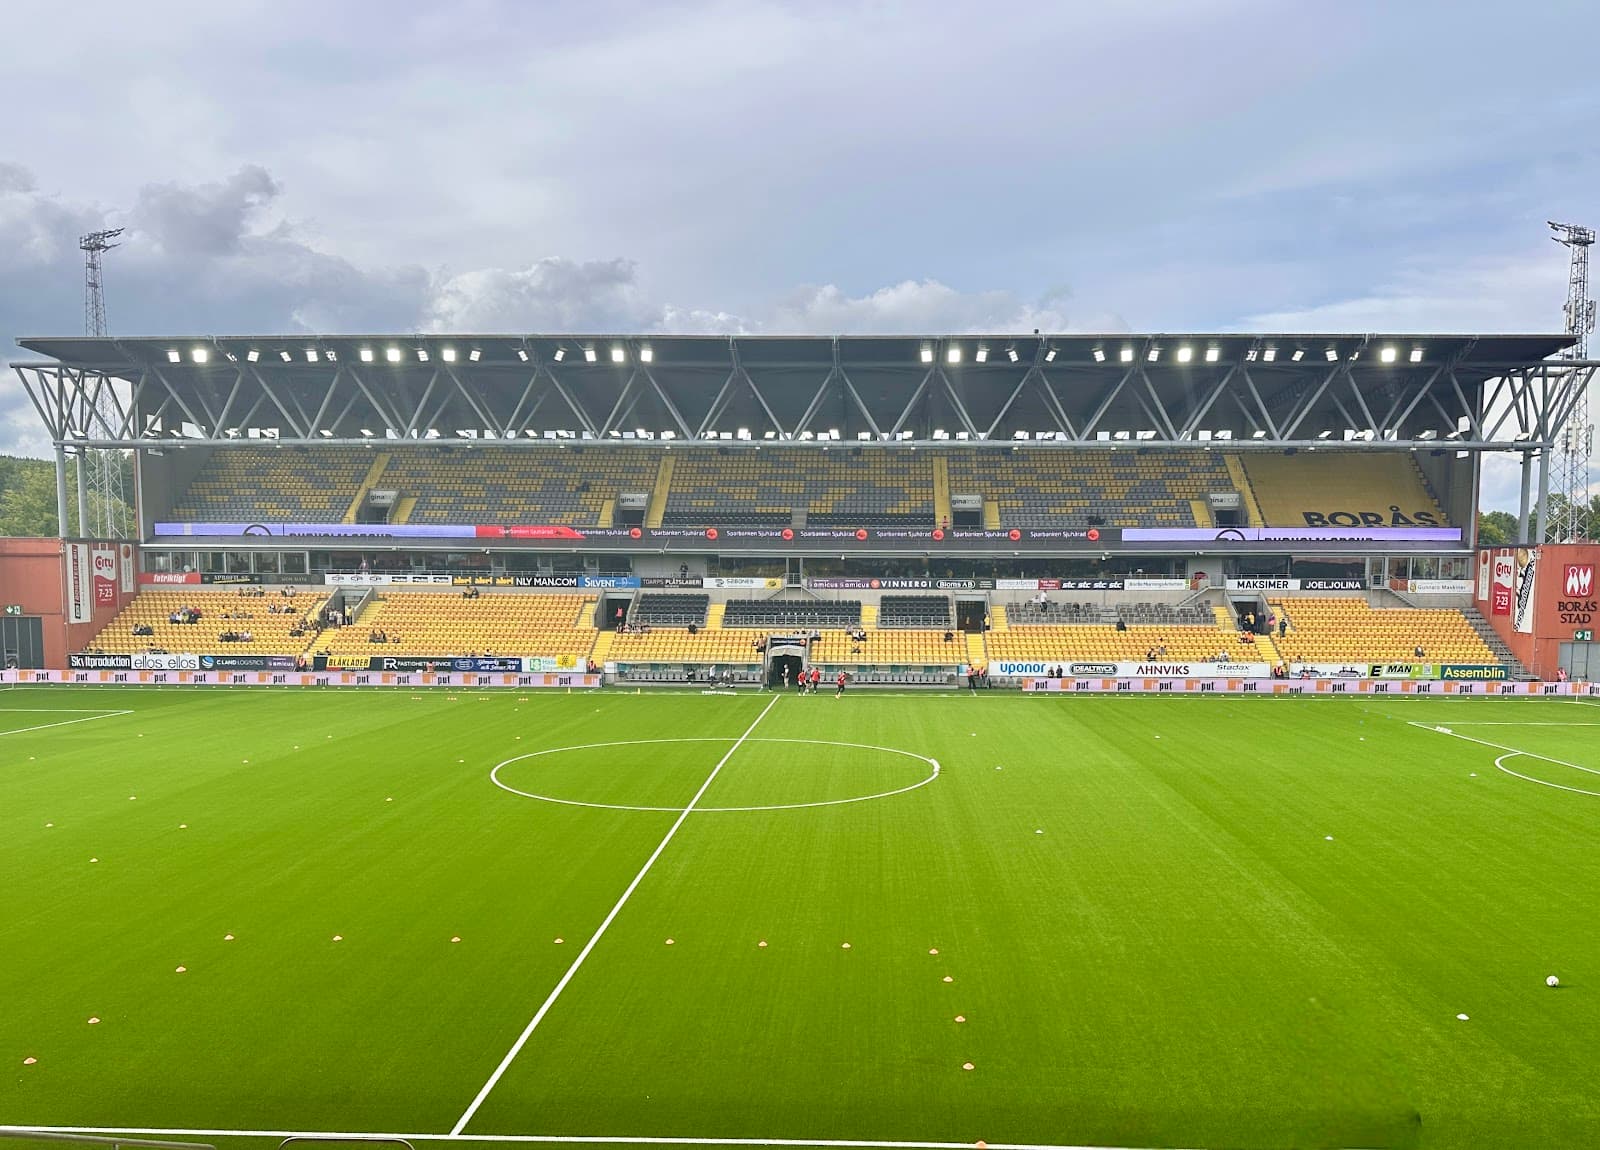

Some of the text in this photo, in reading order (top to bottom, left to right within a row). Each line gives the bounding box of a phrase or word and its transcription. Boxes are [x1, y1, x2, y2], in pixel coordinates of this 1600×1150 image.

[1302, 505, 1440, 528] BORÅS
[584, 577, 616, 588] SILVENT
[881, 580, 931, 588] VINNERGI
[1237, 580, 1289, 589] MAKSIMER
[1305, 581, 1361, 589] JOELJOLINA
[98, 588, 113, 598] 7-23
[1496, 596, 1508, 607] 7-23
[1558, 600, 1598, 612] BORÅS
[1560, 613, 1592, 624] STAD
[134, 656, 196, 669] ellos ellos
[1000, 663, 1046, 674] uponor
[1136, 665, 1190, 675] AHNVIKS
[1443, 667, 1505, 679] Assemblin
